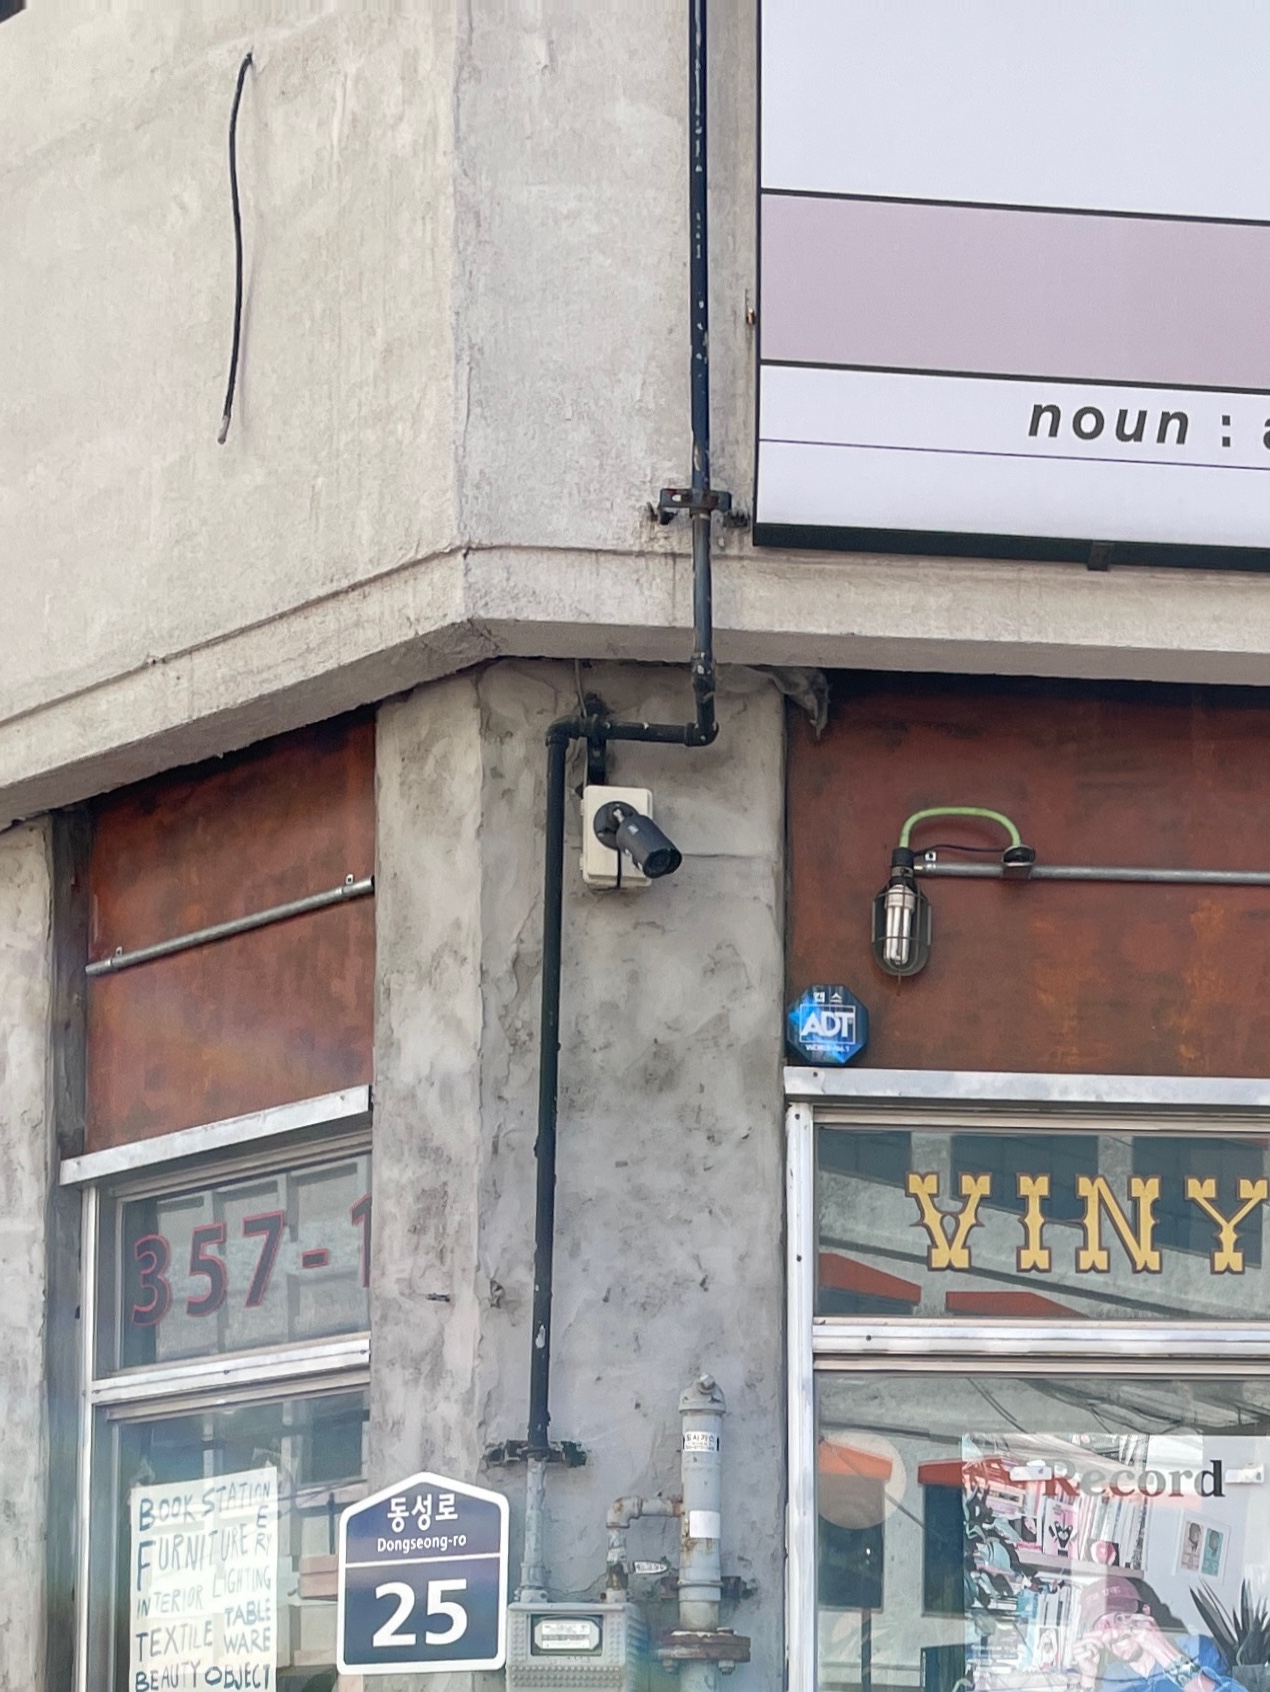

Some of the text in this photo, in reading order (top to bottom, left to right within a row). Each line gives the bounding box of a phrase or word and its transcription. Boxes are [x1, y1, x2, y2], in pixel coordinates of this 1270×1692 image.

[1028, 403, 1190, 446] noun
[800, 1010, 855, 1038] ADT
[1042, 1459, 1226, 1498] Record
[139, 1494, 196, 1531] BOOK
[387, 1493, 458, 1533] 동성로
[137, 1523, 248, 1591] FURNITURE
[377, 1534, 467, 1554] Dongseong-ro
[137, 1565, 272, 1619] INTERIOR LIGHTING
[371, 1578, 468, 1648] 25
[136, 1620, 213, 1662] TEXTILE
[223, 1627, 271, 1656] WARE
[204, 1662, 271, 1690] OBJECT
